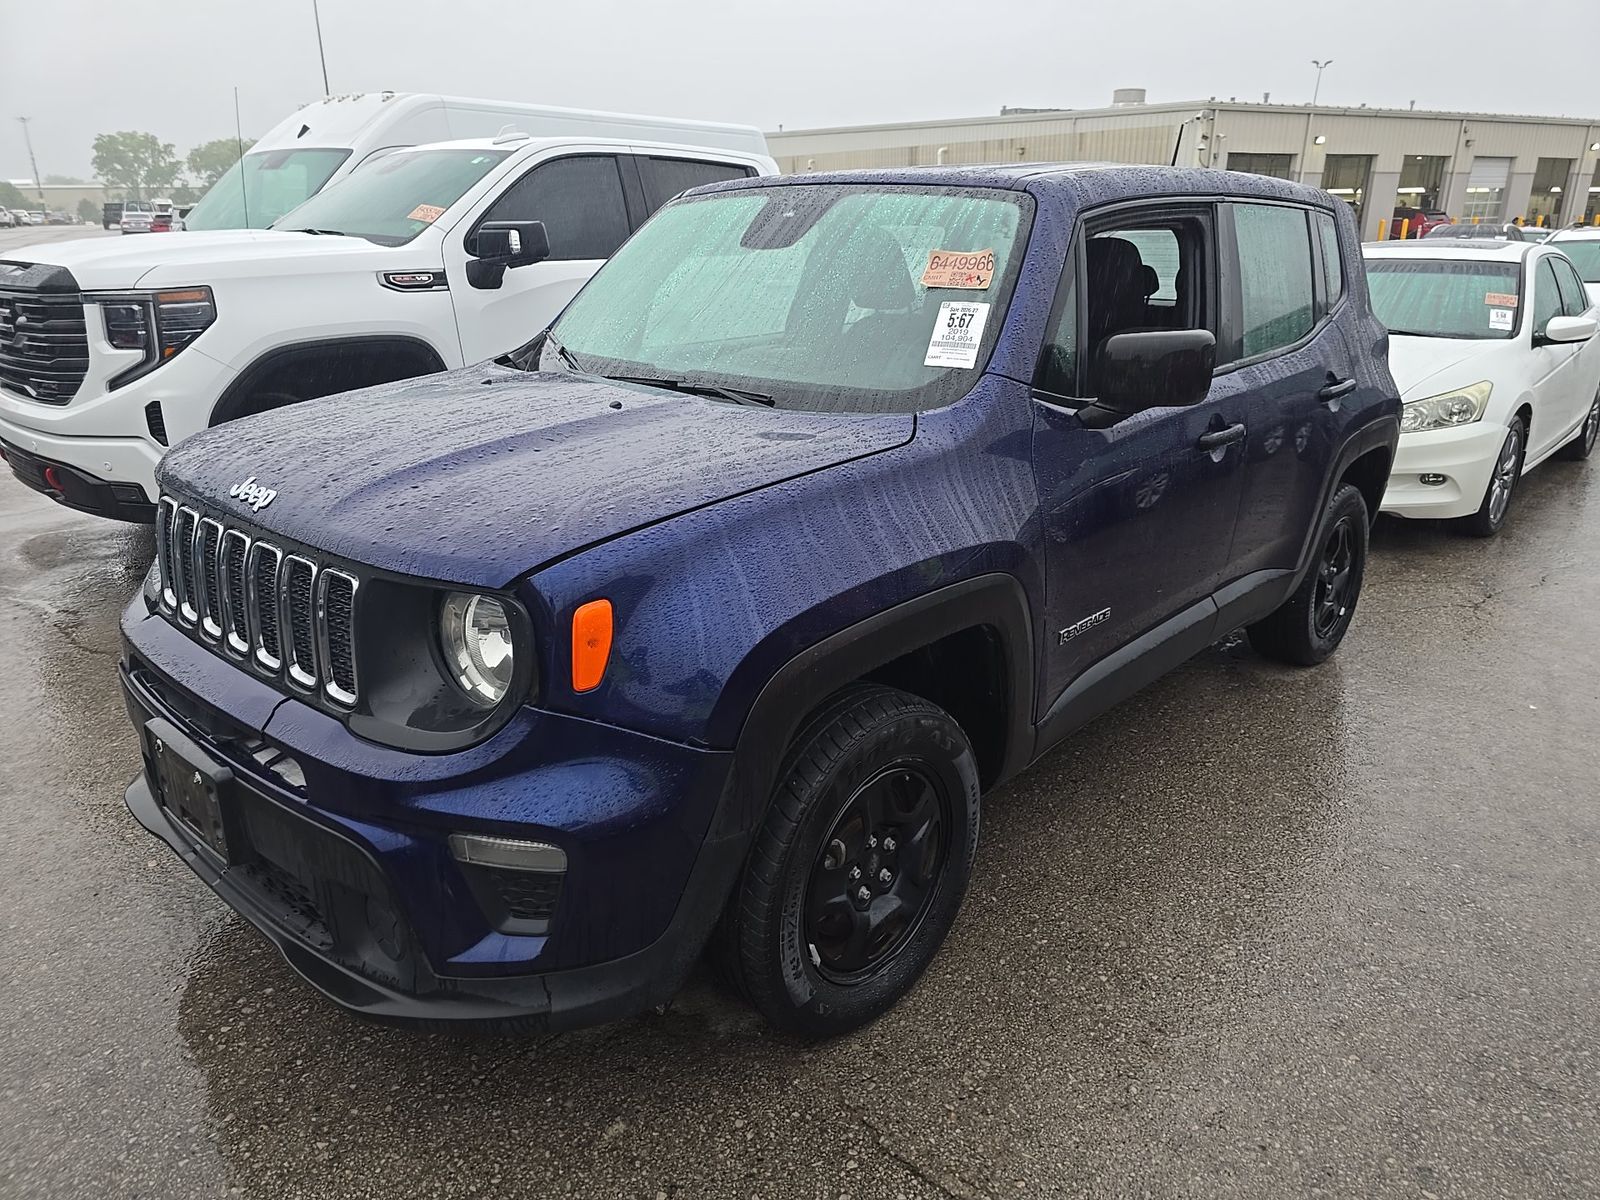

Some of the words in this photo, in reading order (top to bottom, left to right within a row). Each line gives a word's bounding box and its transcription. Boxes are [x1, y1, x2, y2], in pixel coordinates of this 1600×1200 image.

[930, 253, 993, 271] 6449966
[947, 312, 975, 328] 5:67
[229, 476, 278, 513] Jeep
